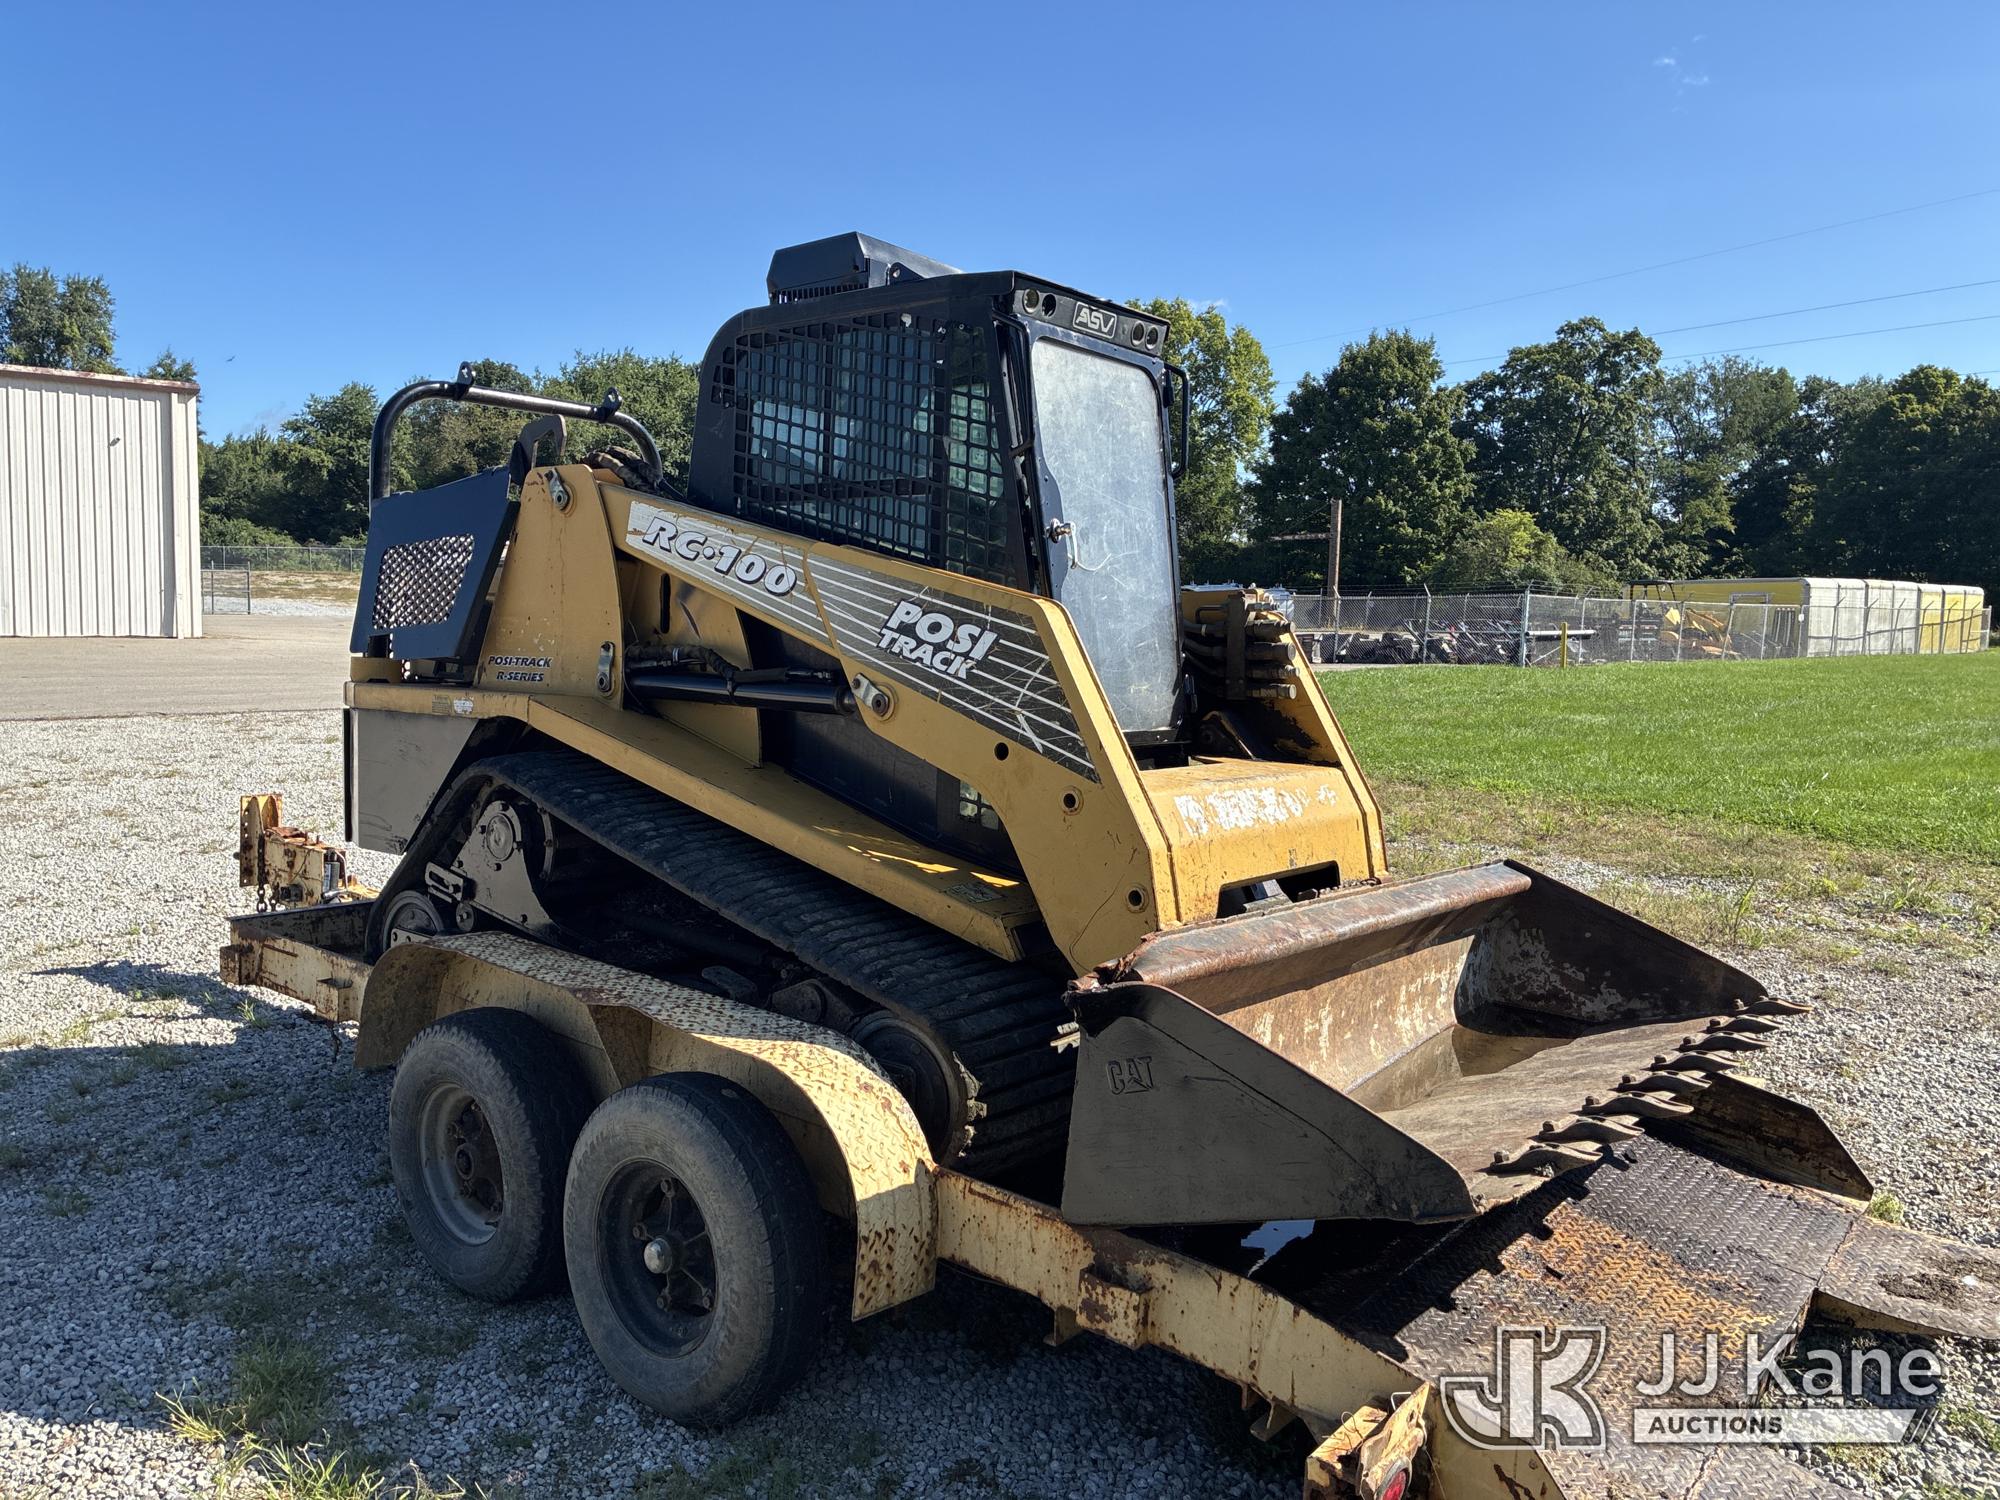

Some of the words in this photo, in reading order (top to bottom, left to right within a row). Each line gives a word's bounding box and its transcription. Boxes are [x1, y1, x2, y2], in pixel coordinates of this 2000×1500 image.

[1075, 307, 1115, 333] ASV
[885, 601, 1000, 662] POSI
[488, 655, 552, 668] POSI-TRACK
[877, 627, 983, 680] TRACK
[496, 671, 544, 682] R-SERIES
[1107, 1056, 1154, 1095] CAT
